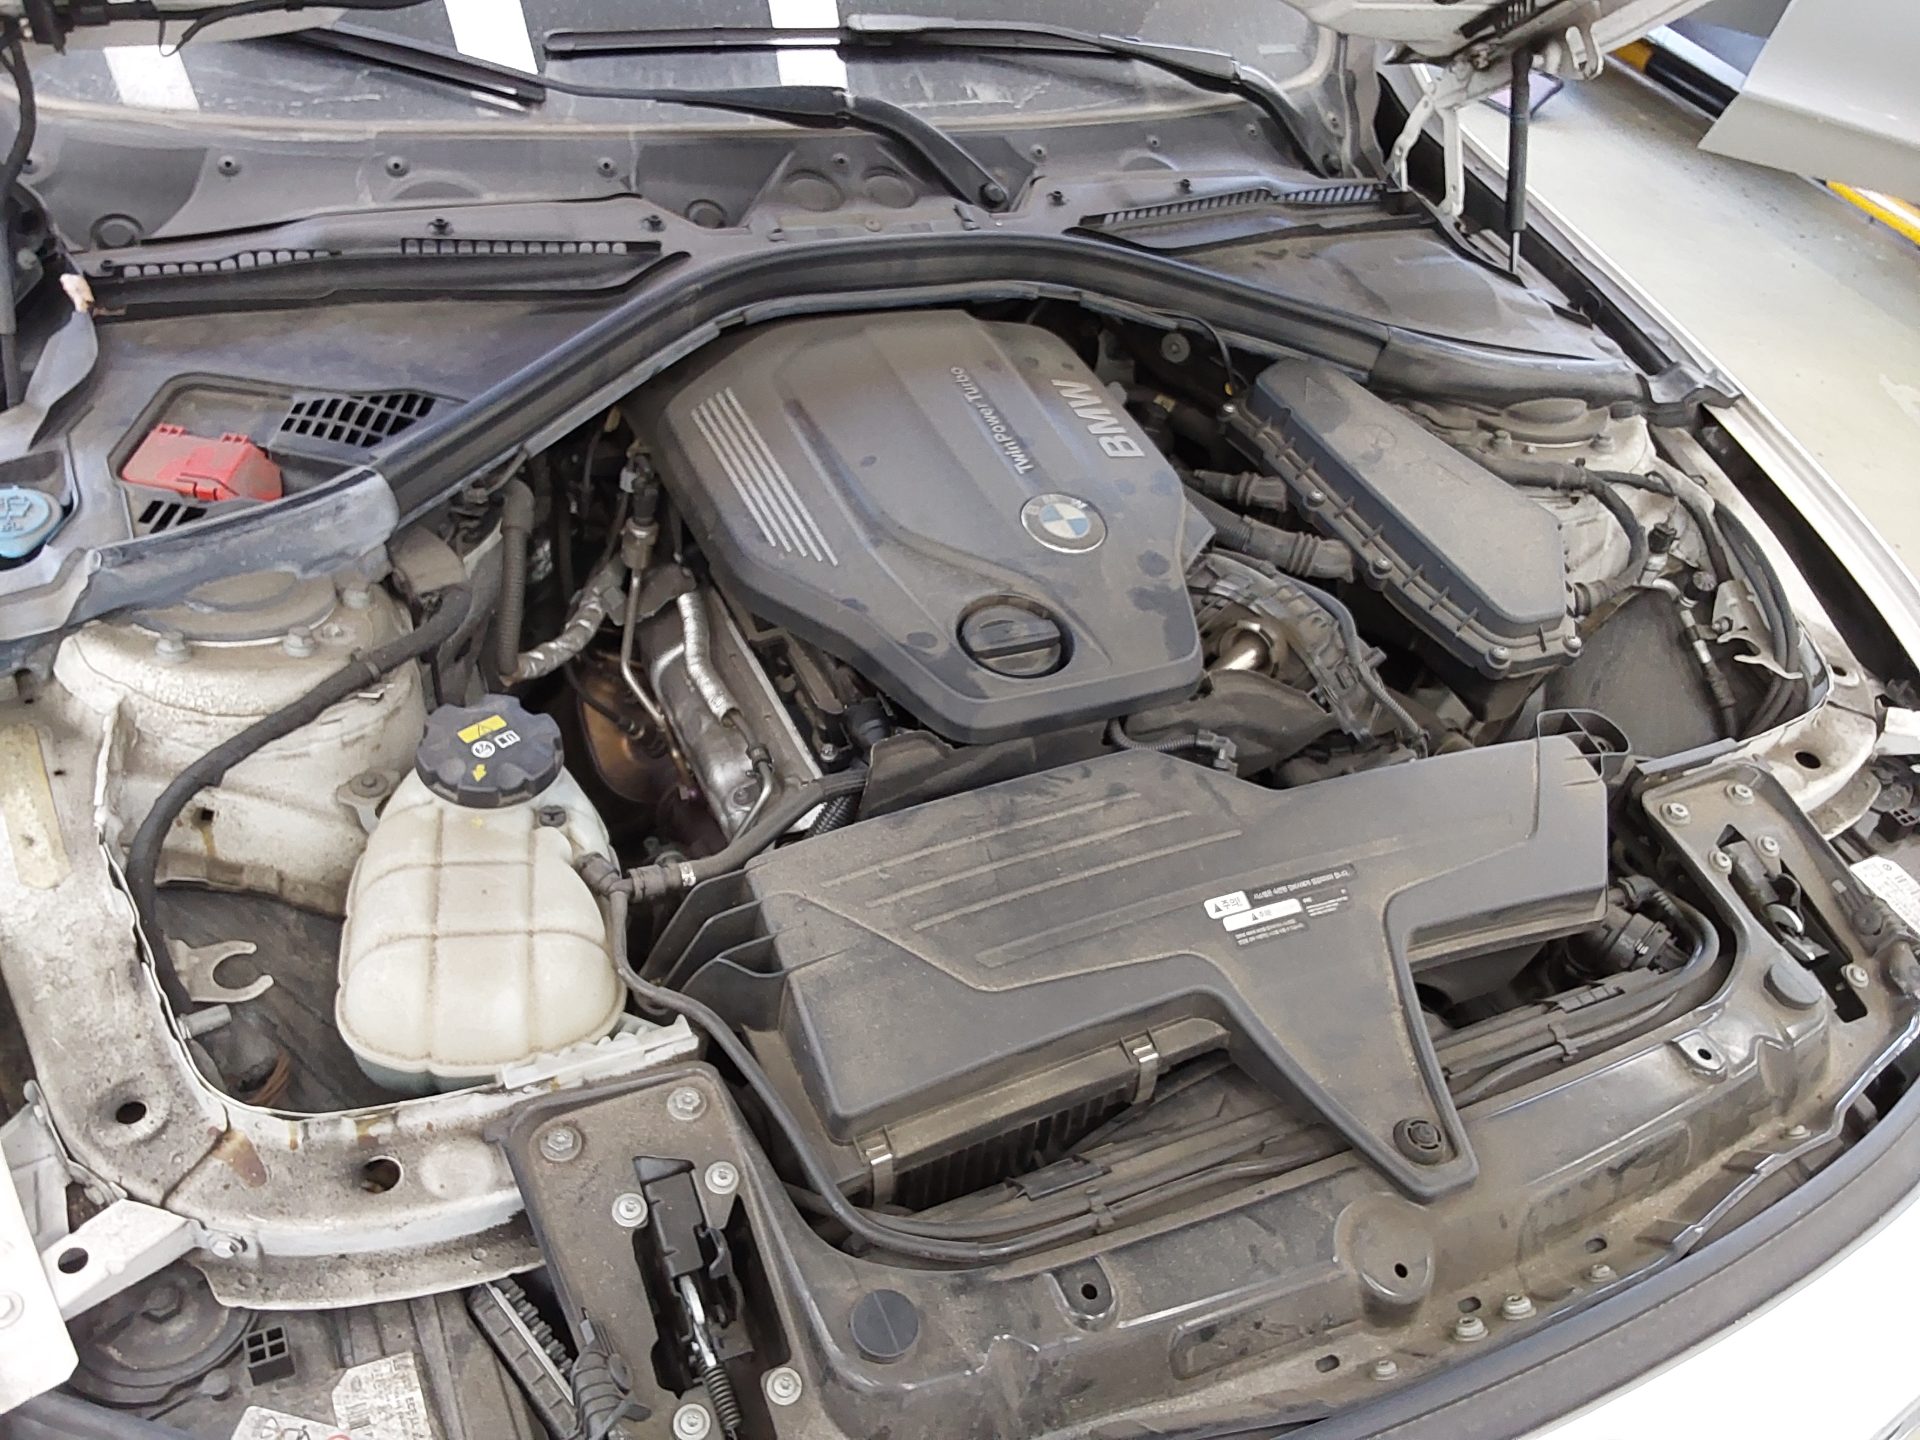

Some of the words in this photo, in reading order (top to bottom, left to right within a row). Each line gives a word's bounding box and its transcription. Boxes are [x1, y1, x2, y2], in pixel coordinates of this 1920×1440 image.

[950, 366, 982, 405] Turbo
[1051, 379, 1145, 458] BMW
[977, 402, 1034, 475] TwinPower
